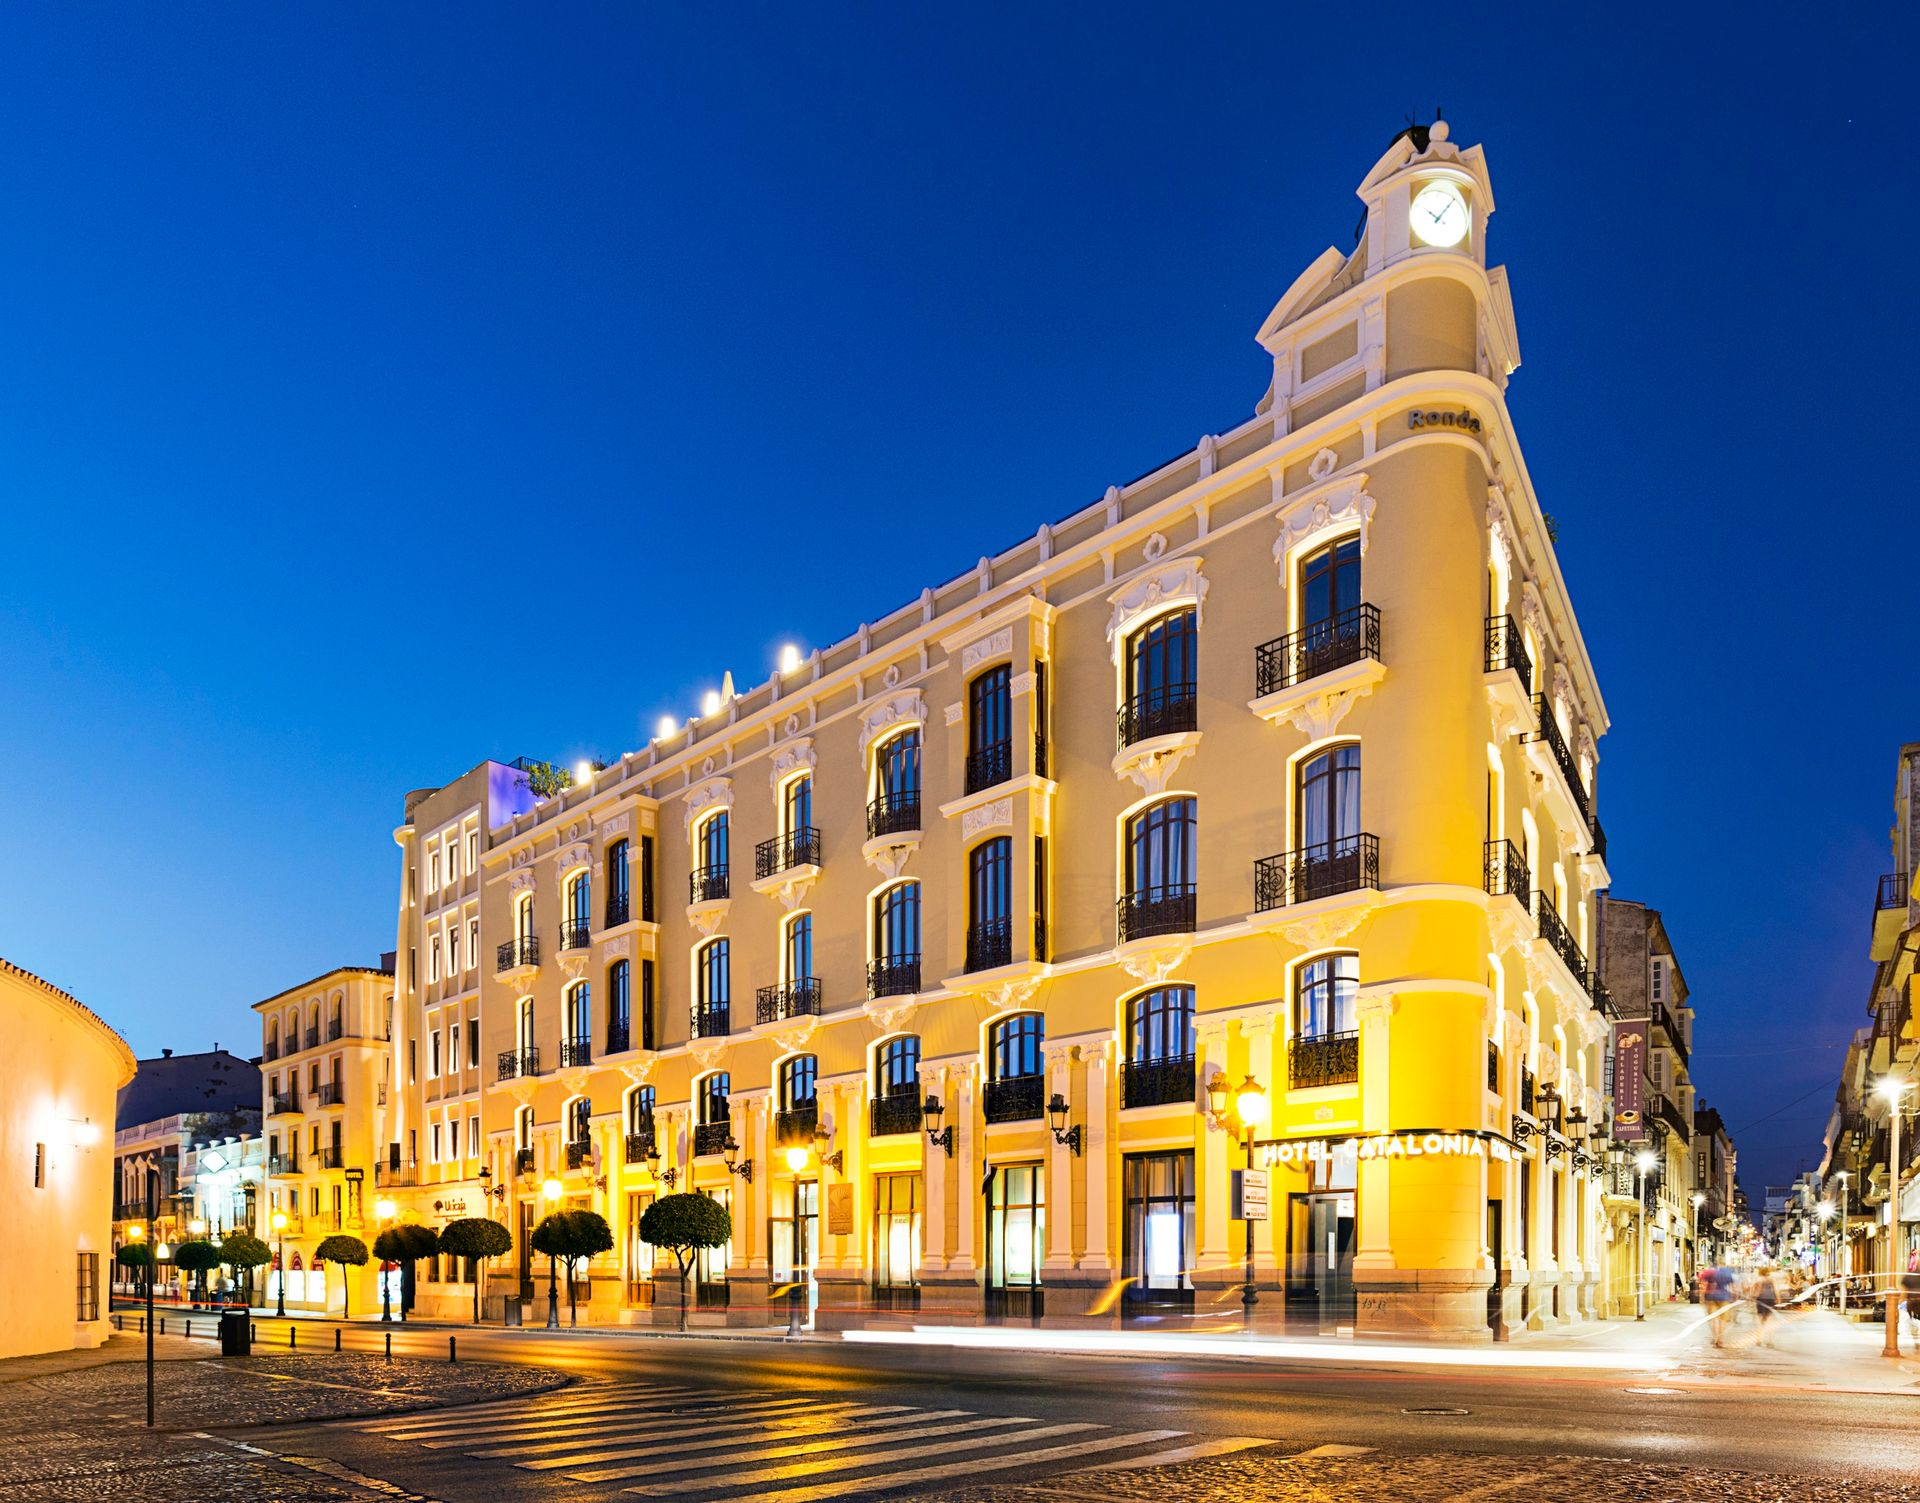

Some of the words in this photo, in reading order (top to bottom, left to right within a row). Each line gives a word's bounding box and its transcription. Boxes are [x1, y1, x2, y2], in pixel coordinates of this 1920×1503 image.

[1408, 408, 1480, 432] Ronda
[1262, 1141, 1333, 1165] HOTEL
[1342, 1134, 1484, 1158] CATALONIA
